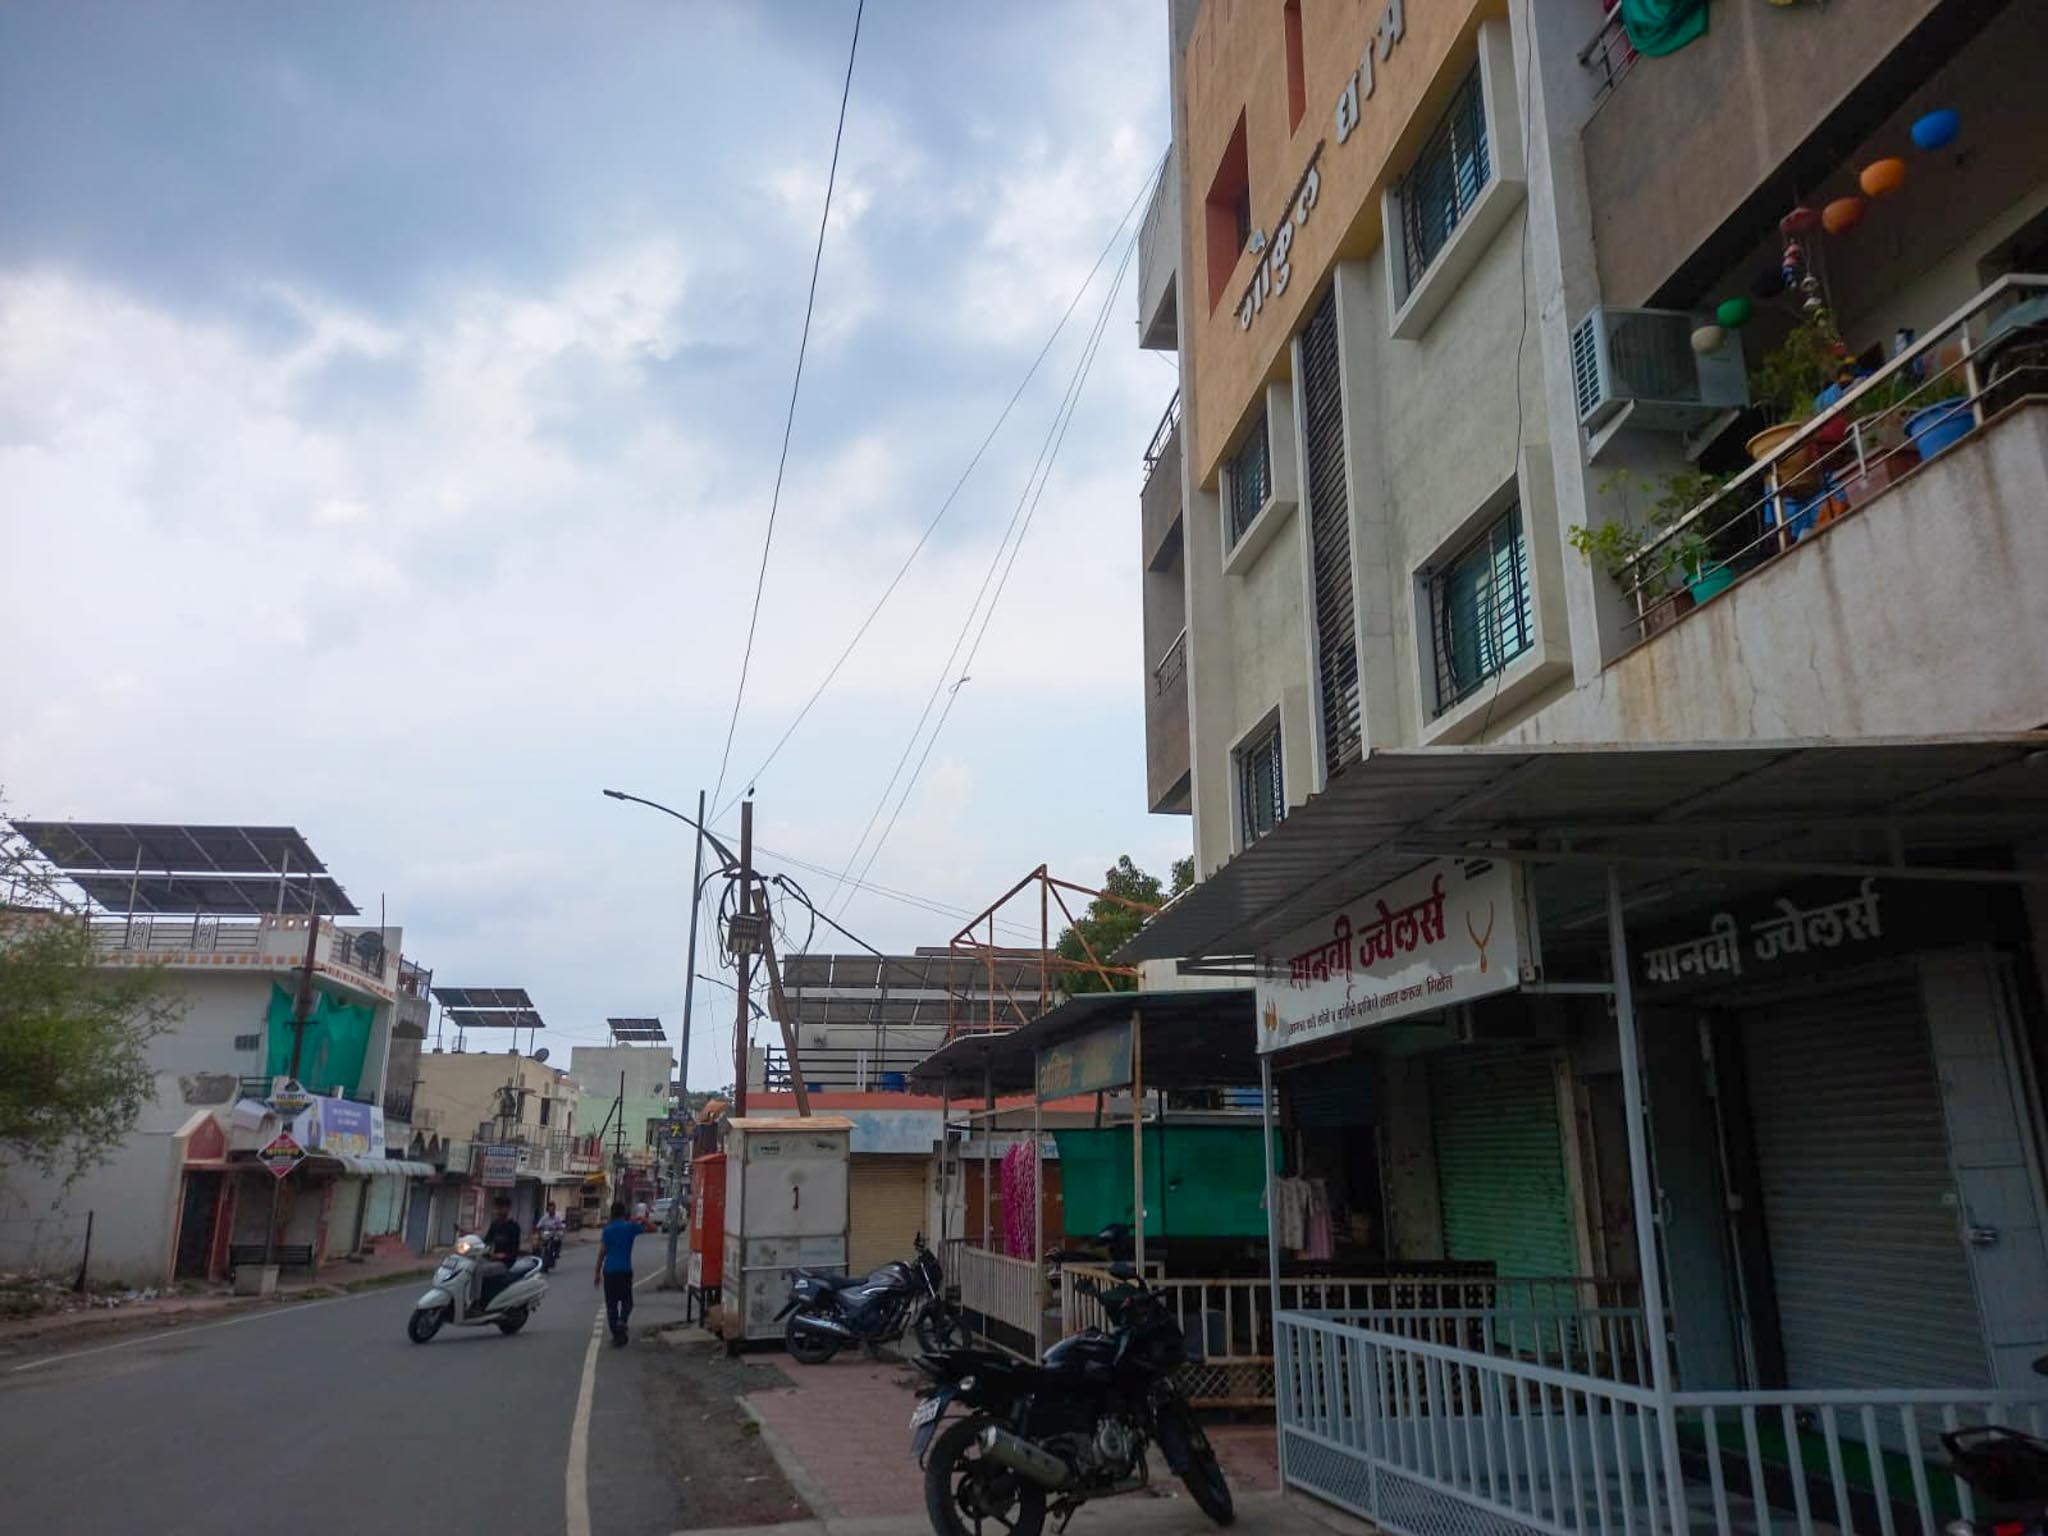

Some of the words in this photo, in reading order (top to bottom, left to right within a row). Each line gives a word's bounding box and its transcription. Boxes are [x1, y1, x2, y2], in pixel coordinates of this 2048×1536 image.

[1287, 914, 1354, 990] मानवी
[1358, 873, 1447, 969] ज्वेलर्स
[1642, 912, 1742, 983] मानवी
[1751, 876, 1882, 961] ज्वेलर्स
